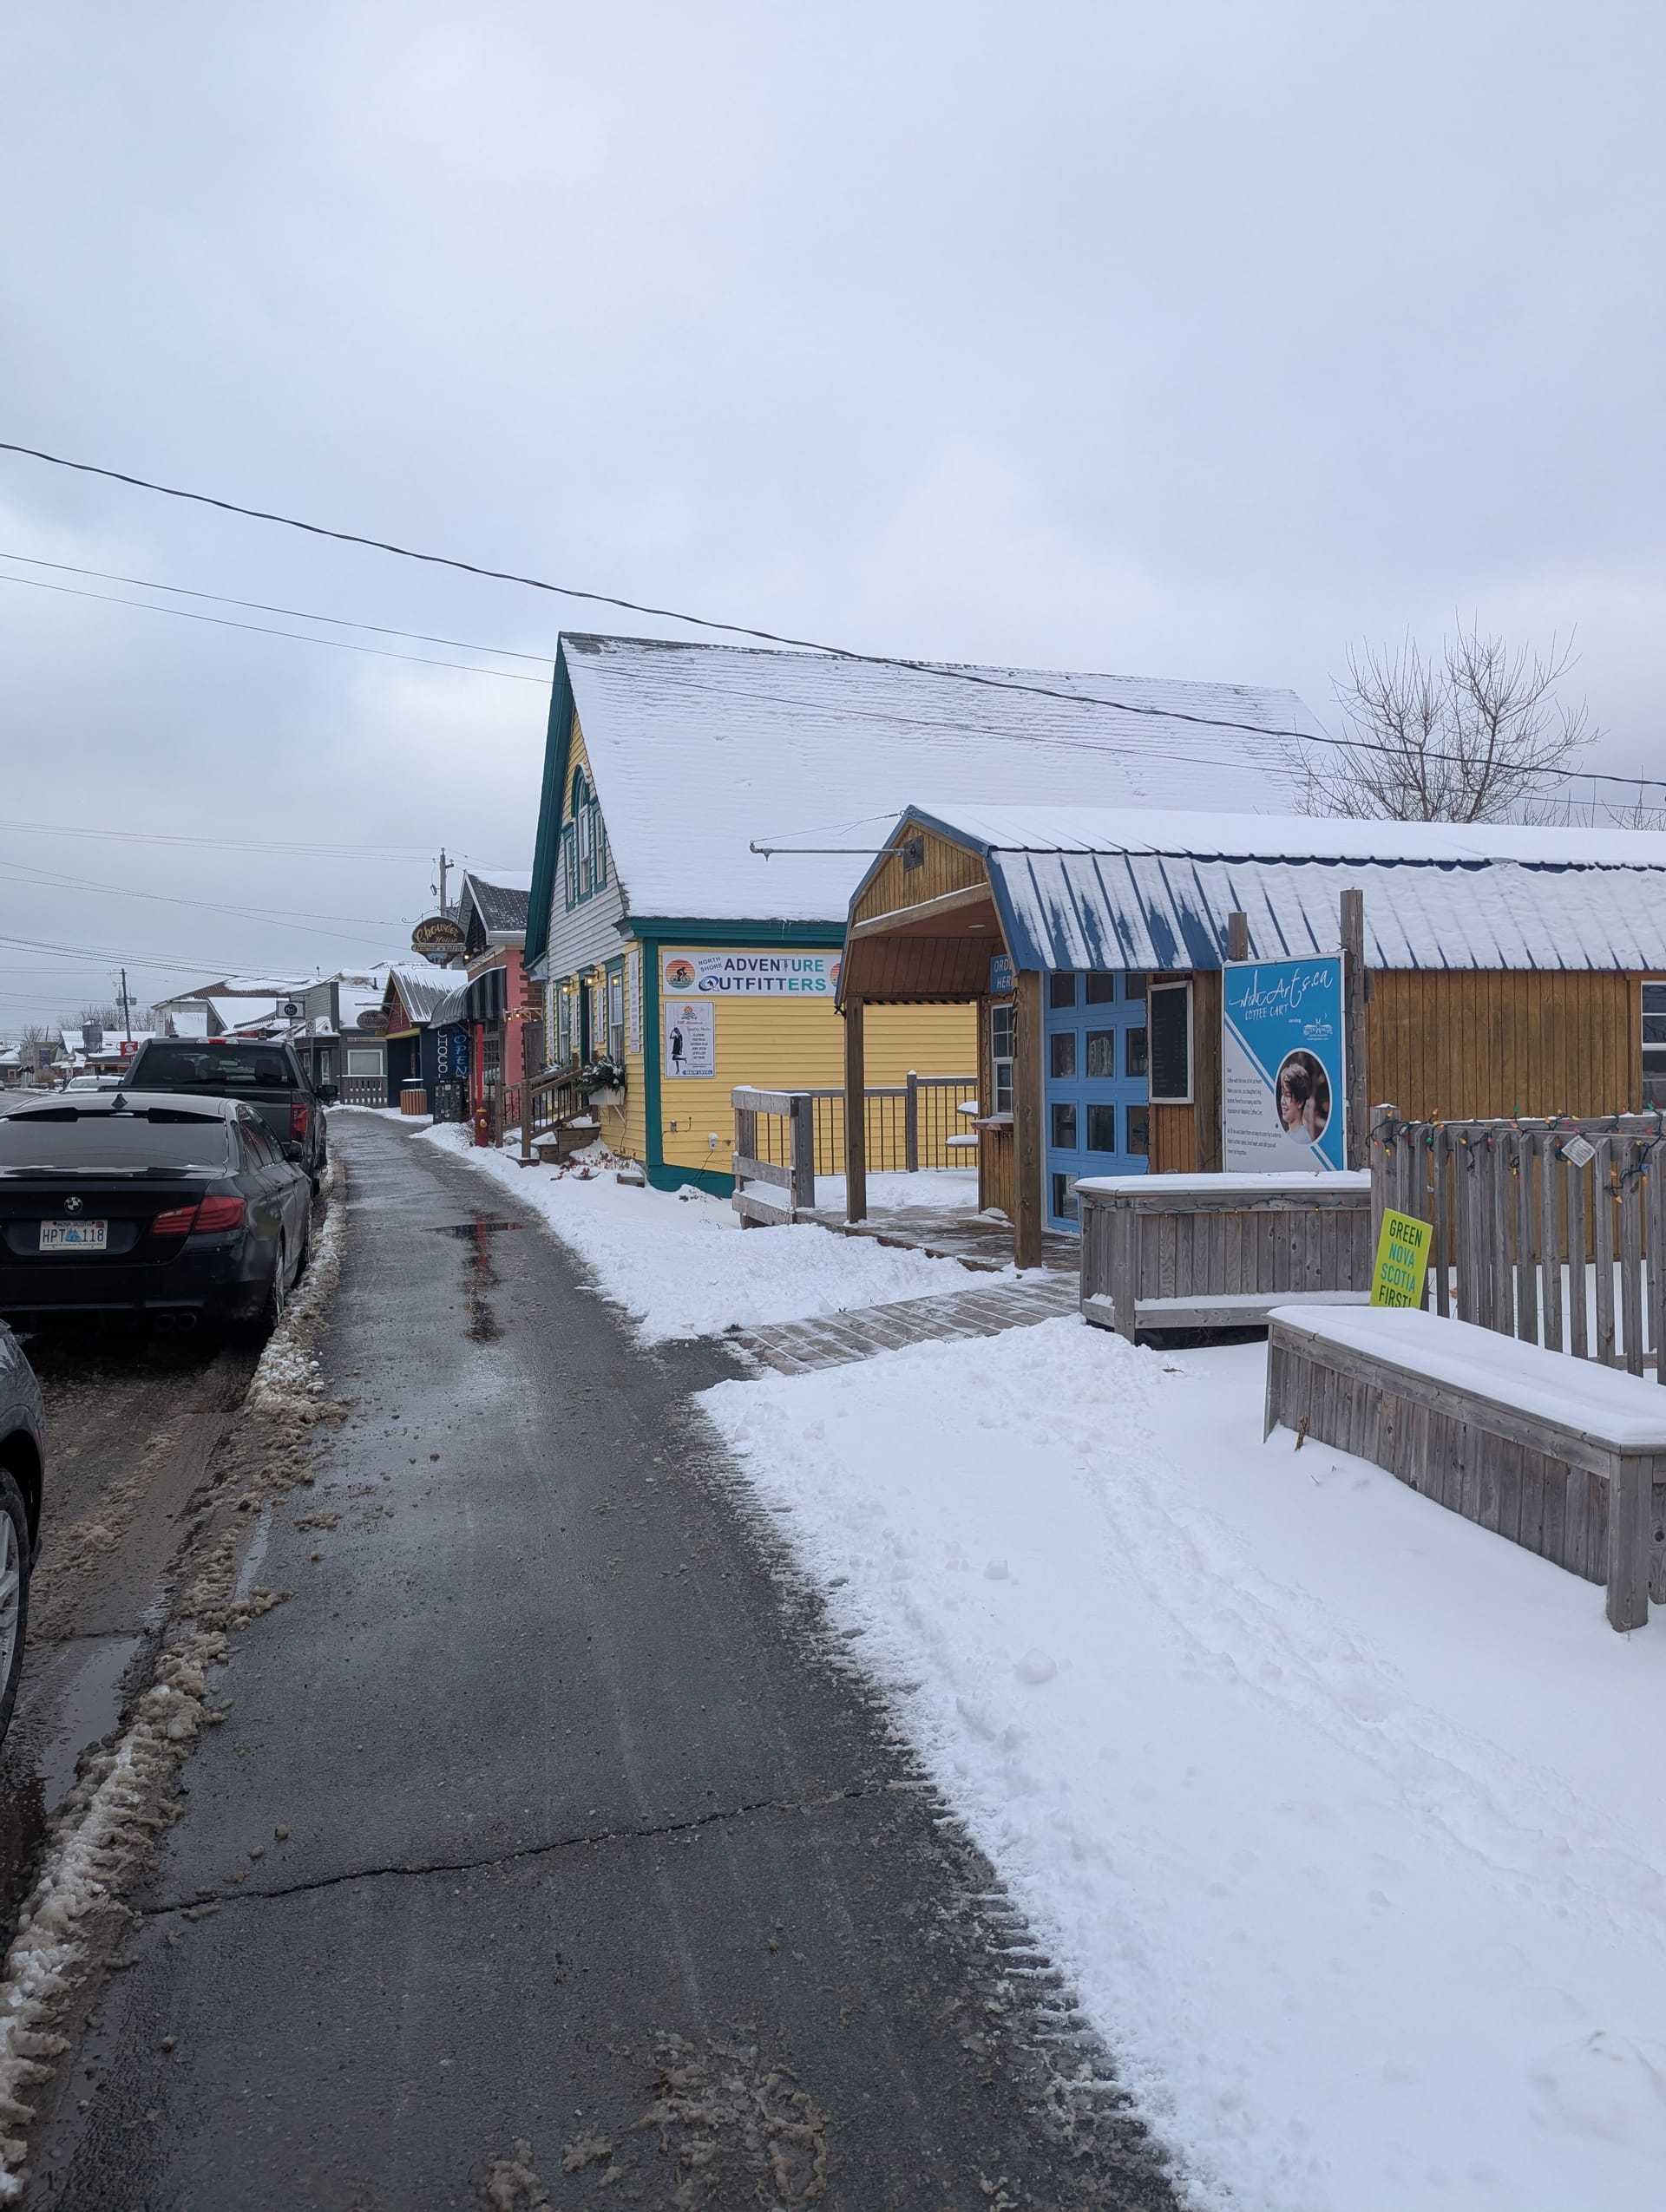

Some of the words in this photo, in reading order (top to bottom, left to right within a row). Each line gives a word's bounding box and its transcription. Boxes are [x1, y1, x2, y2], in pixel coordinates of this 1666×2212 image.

[414, 923, 458, 943] Chowder
[698, 956, 721, 965] NORTH
[700, 963, 723, 972] SHORE
[724, 959, 824, 972] ADVENTURE
[1269, 1003, 1289, 1017] CART
[454, 1035, 467, 1077] OPEN
[43, 1229, 65, 1242] HPT
[82, 1229, 104, 1242] 118
[1390, 1220, 1422, 1247] GREEN
[1389, 1242, 1415, 1269] NOVA
[1381, 1263, 1415, 1293] SCOTIA
